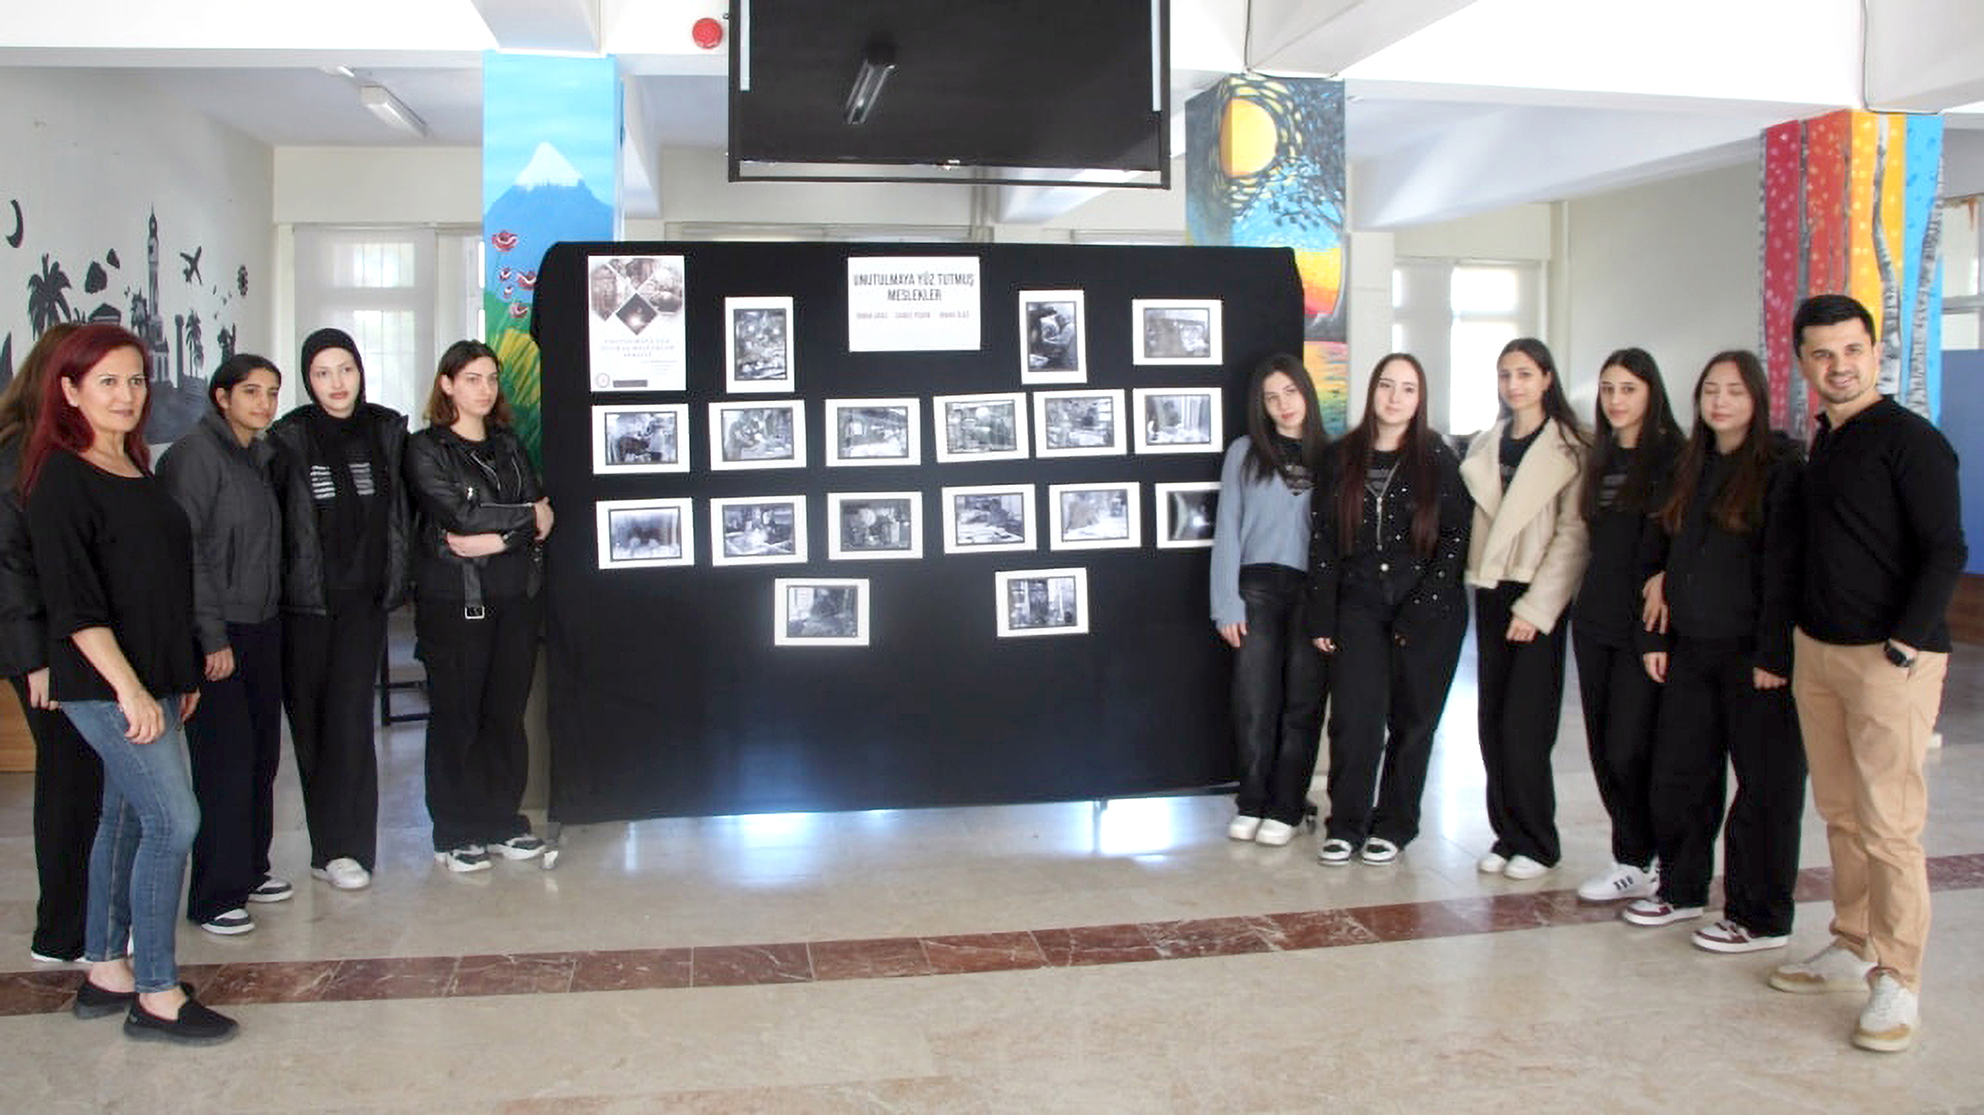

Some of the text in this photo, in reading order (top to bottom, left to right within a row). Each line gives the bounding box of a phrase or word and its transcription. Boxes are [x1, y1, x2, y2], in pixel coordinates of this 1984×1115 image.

[853, 271, 975, 287] UNUTULMAYA YÜZ TUTMUŞ
[887, 289, 941, 301] MESLEKLER
